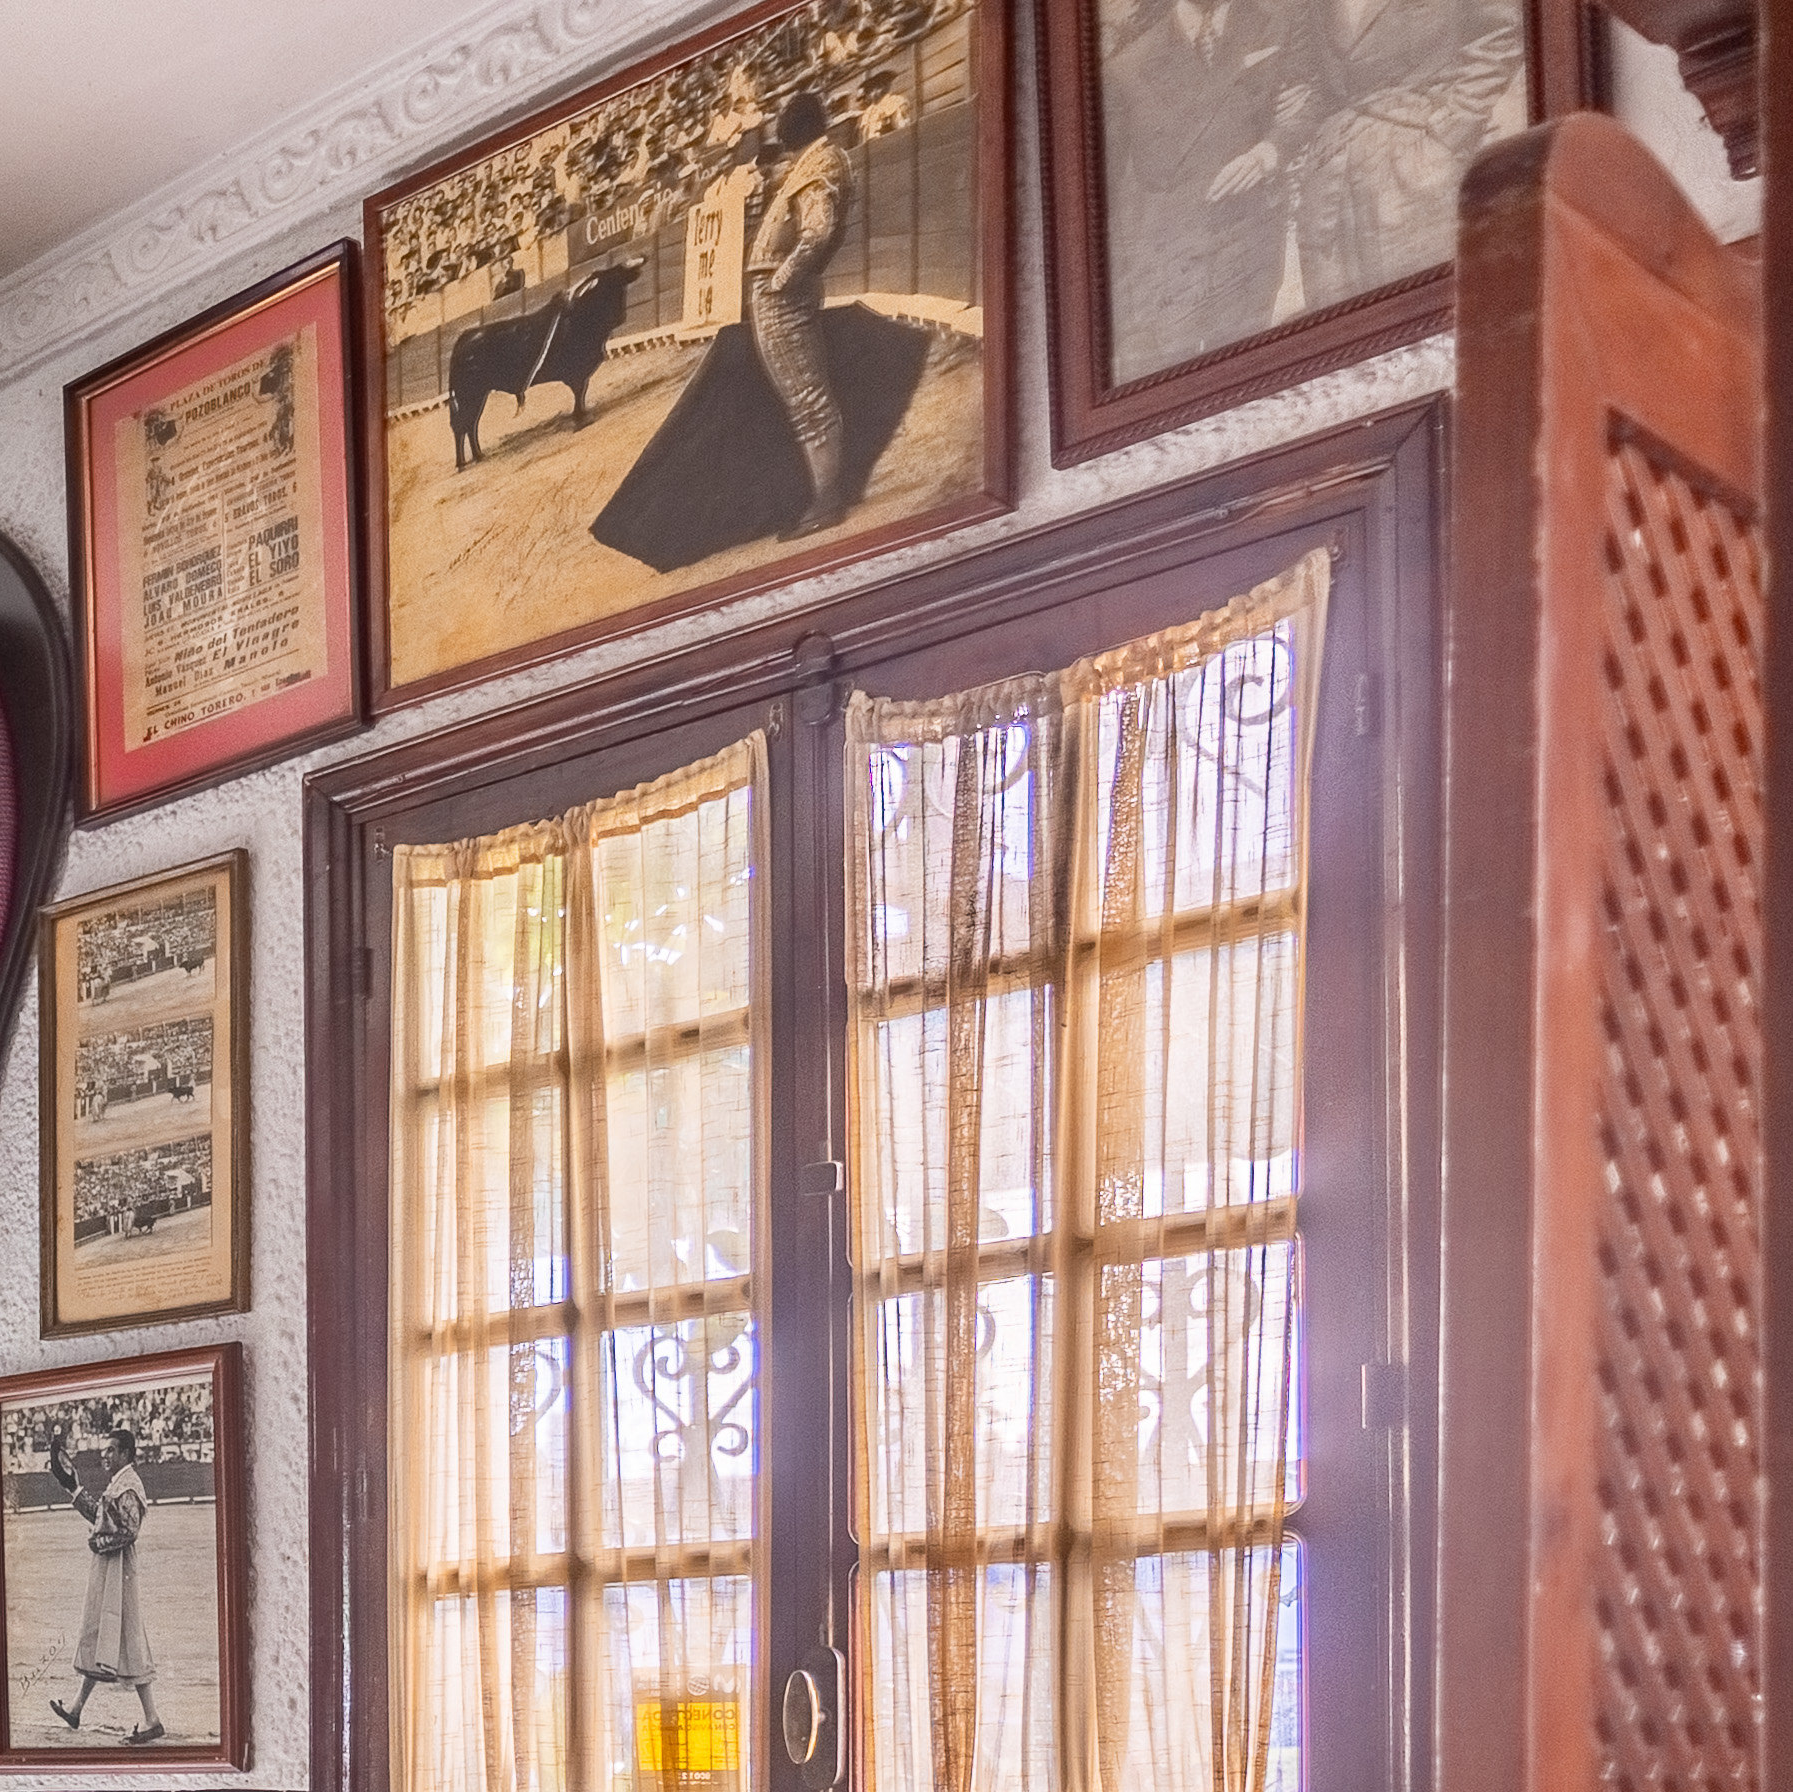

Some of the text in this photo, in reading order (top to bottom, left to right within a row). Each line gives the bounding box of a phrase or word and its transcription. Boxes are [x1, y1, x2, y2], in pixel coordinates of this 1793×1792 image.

[170, 390, 200, 411] PLAZA
[203, 384, 215, 396] DE
[219, 367, 250, 387] TOROS
[185, 382, 251, 423] POZOBLANCO
[233, 499, 259, 521] BRAVOS
[248, 515, 299, 551] PAQUIRRI
[248, 534, 299, 569] EL YIYO
[143, 564, 174, 588] FERMIN
[176, 545, 222, 573] BOHORQUEZ
[143, 577, 179, 602] ALVARO
[185, 559, 222, 585] DOMECQ
[249, 567, 262, 587] EL
[269, 551, 299, 578] SORO
[143, 575, 223, 617] LUIS VALDENEBRO
[183, 586, 223, 612] MOURA
[170, 615, 223, 641] HERMOSOS
[174, 605, 300, 662] Niño del Tentadero
[212, 644, 228, 662] El
[236, 619, 301, 652] Vinagre
[154, 675, 188, 698] Manuel
[223, 637, 289, 671] Manolo
[164, 711, 195, 730] CHINO
